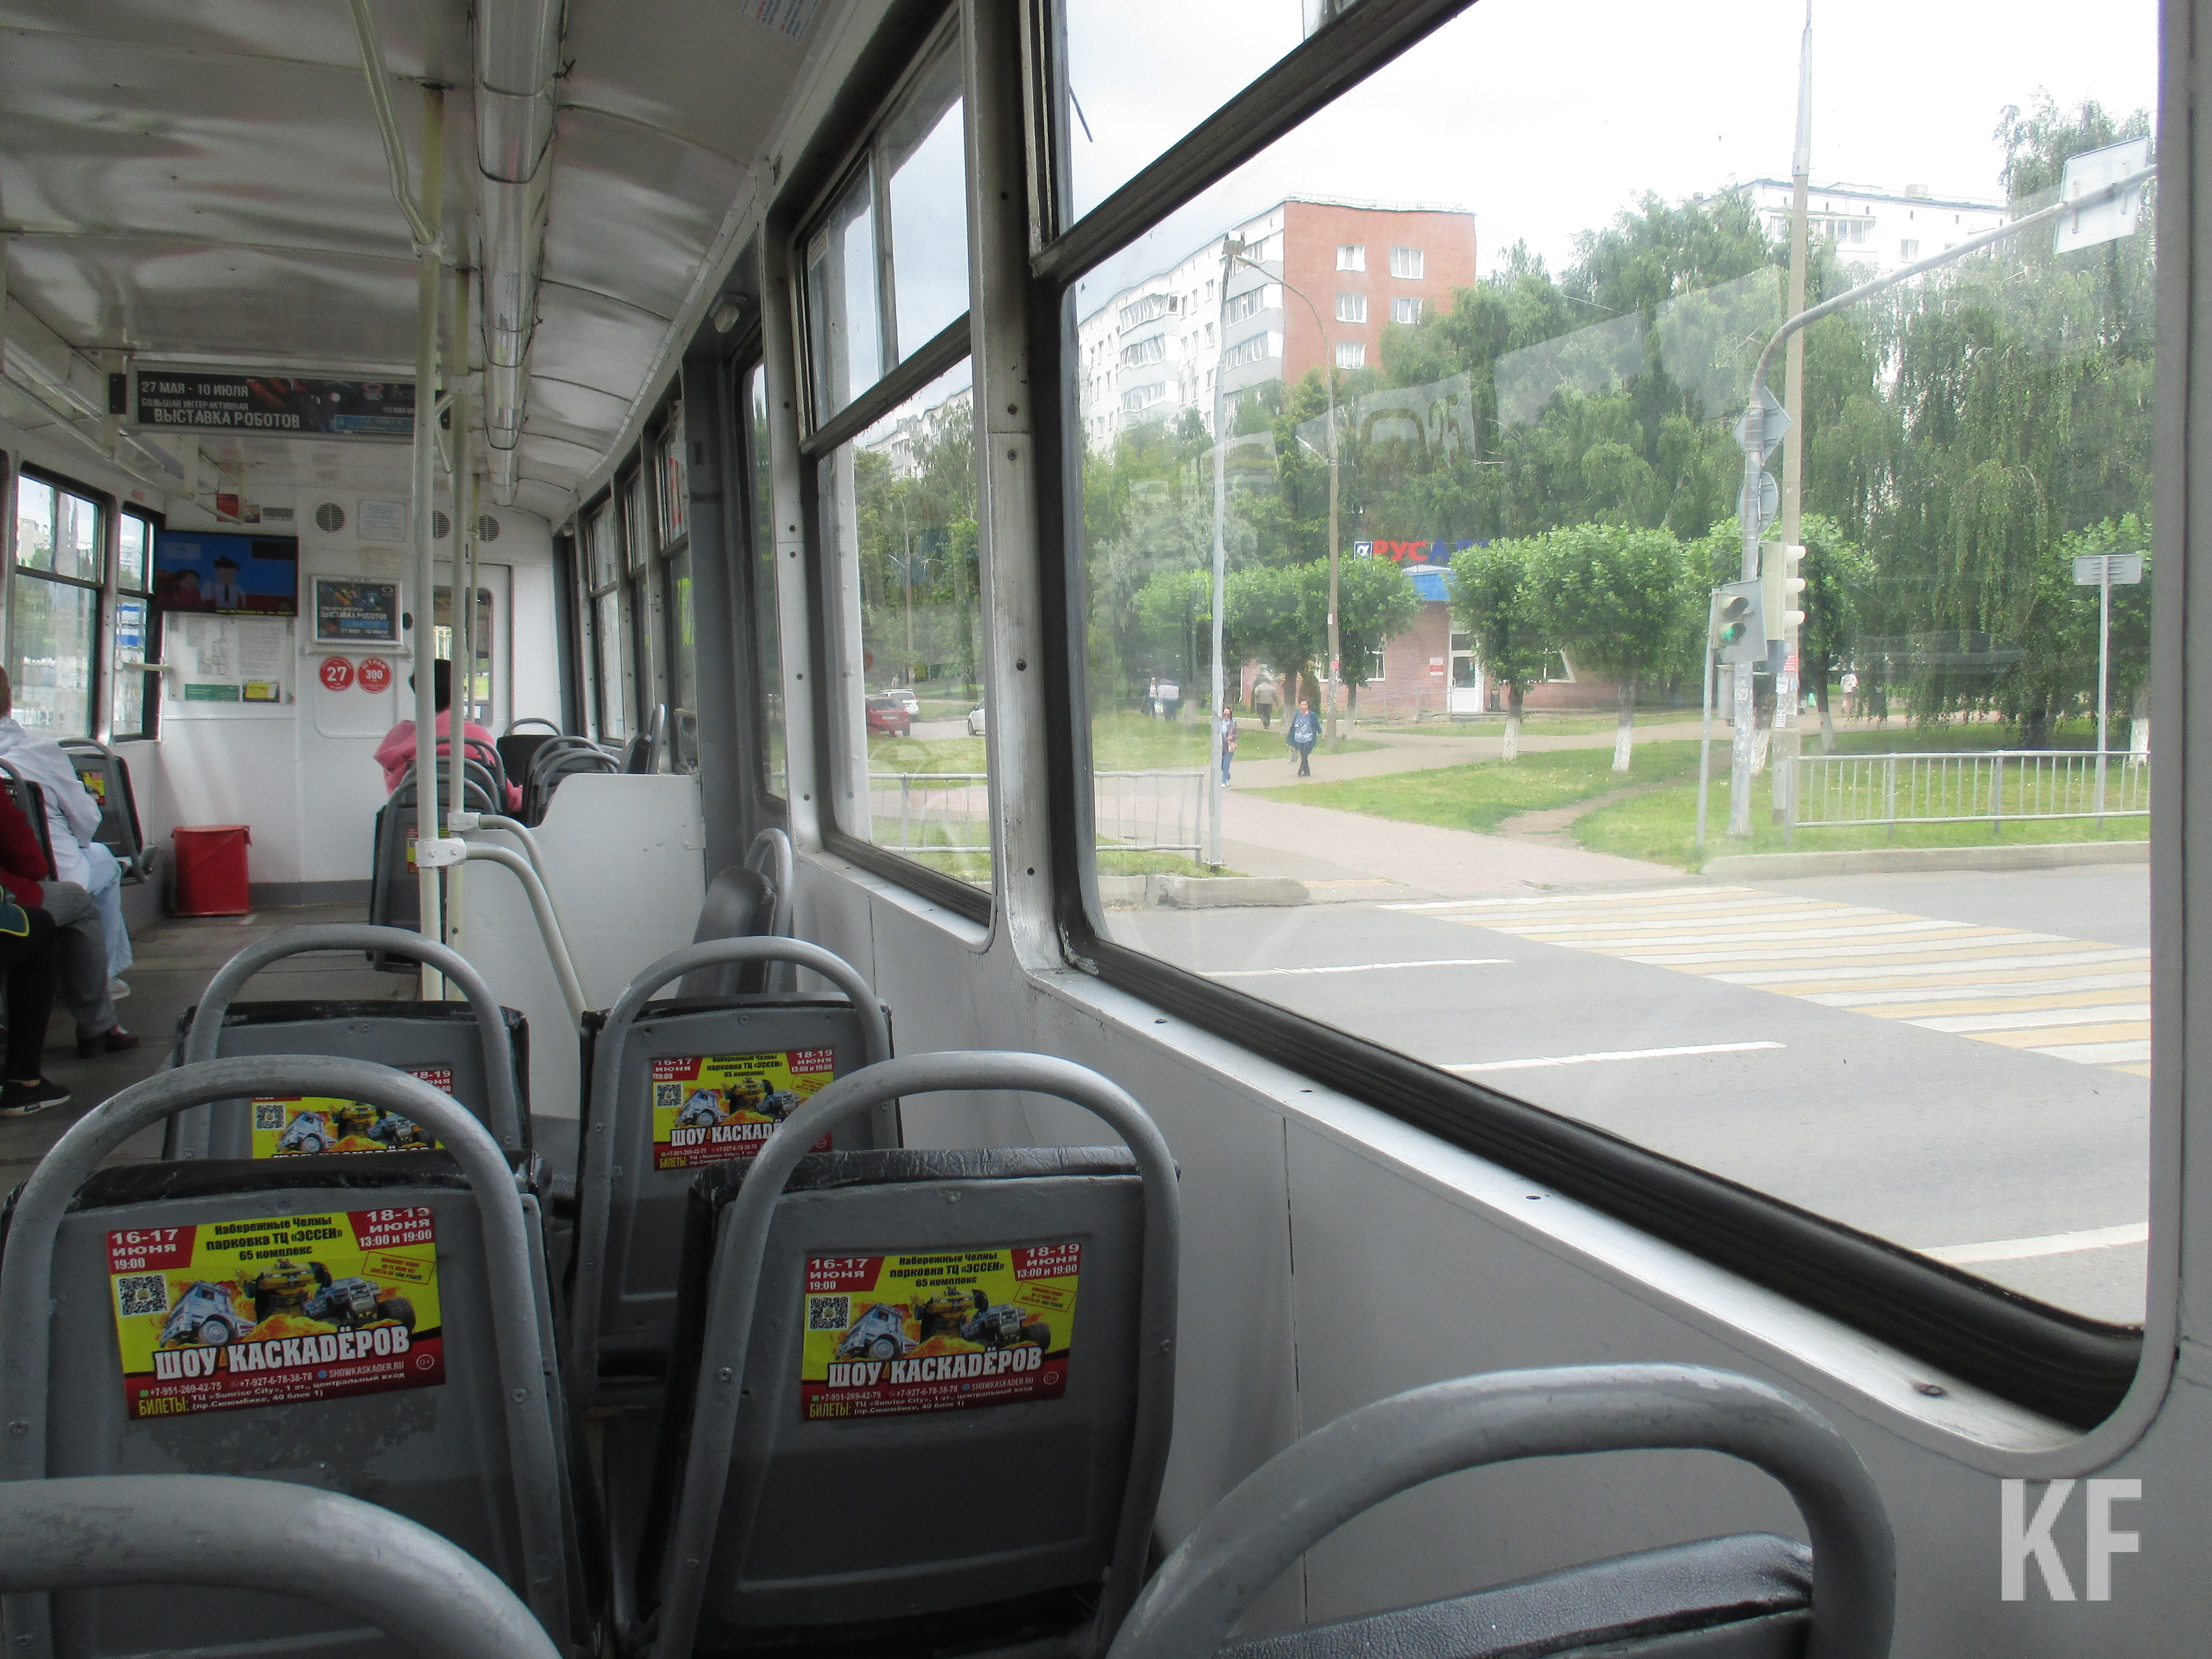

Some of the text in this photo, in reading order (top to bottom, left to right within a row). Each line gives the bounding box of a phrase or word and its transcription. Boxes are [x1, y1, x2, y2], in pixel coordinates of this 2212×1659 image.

[141, 381, 156, 393] 27
[160, 382, 185, 394] МАЯ
[197, 384, 211, 396] 10
[214, 385, 249, 397] ИЮЛЯ
[154, 409, 300, 428] ВЫСТАВКА РОБОТОВ
[361, 661, 386, 669] ШТРАФ
[327, 666, 347, 682] 27
[366, 670, 383, 679] 300
[656, 1057, 692, 1065] 16-17
[796, 1050, 832, 1058] 18-19
[672, 1127, 706, 1146] ШОУ
[366, 1206, 430, 1223] 18-19
[215, 1215, 332, 1235] Набережные Челны
[111, 1228, 180, 1245] 16-17
[206, 1235, 270, 1250] парковка
[272, 1232, 289, 1245] ТЦ
[359, 1234, 390, 1247] 13:00
[401, 1229, 432, 1242] 19:00
[239, 1245, 313, 1261] 65 комплекс
[898, 1250, 998, 1264] Набережные Челны
[1026, 1245, 1079, 1257] 18-19
[113, 1257, 146, 1270] 19:00
[810, 1257, 868, 1271] 16-17
[889, 1265, 943, 1278] парковка
[945, 1263, 959, 1274] ТЦ
[1016, 1267, 1042, 1278] 13:00
[1052, 1264, 1077, 1275] 19:00
[808, 1282, 836, 1293] 19:00
[915, 1275, 977, 1287] 65 комплекс
[154, 1346, 219, 1381] ШОУ
[329, 1361, 404, 1378] SHOWKASKADER.RU
[313, 1374, 379, 1388] центральный
[829, 1361, 882, 1390] ШОУ
[150, 1371, 313, 1397] +7-951-269-42-75 +7-927-6-78-38-78
[896, 1384, 958, 1397] +7-927-6-78-38-78
[972, 1377, 1034, 1390] SHOWKASKADER.RU
[286, 1390, 311, 1399] блок
[138, 1395, 189, 1416] БИЛЕТЫ:
[808, 1403, 852, 1420] БИЛЕТЫ:
